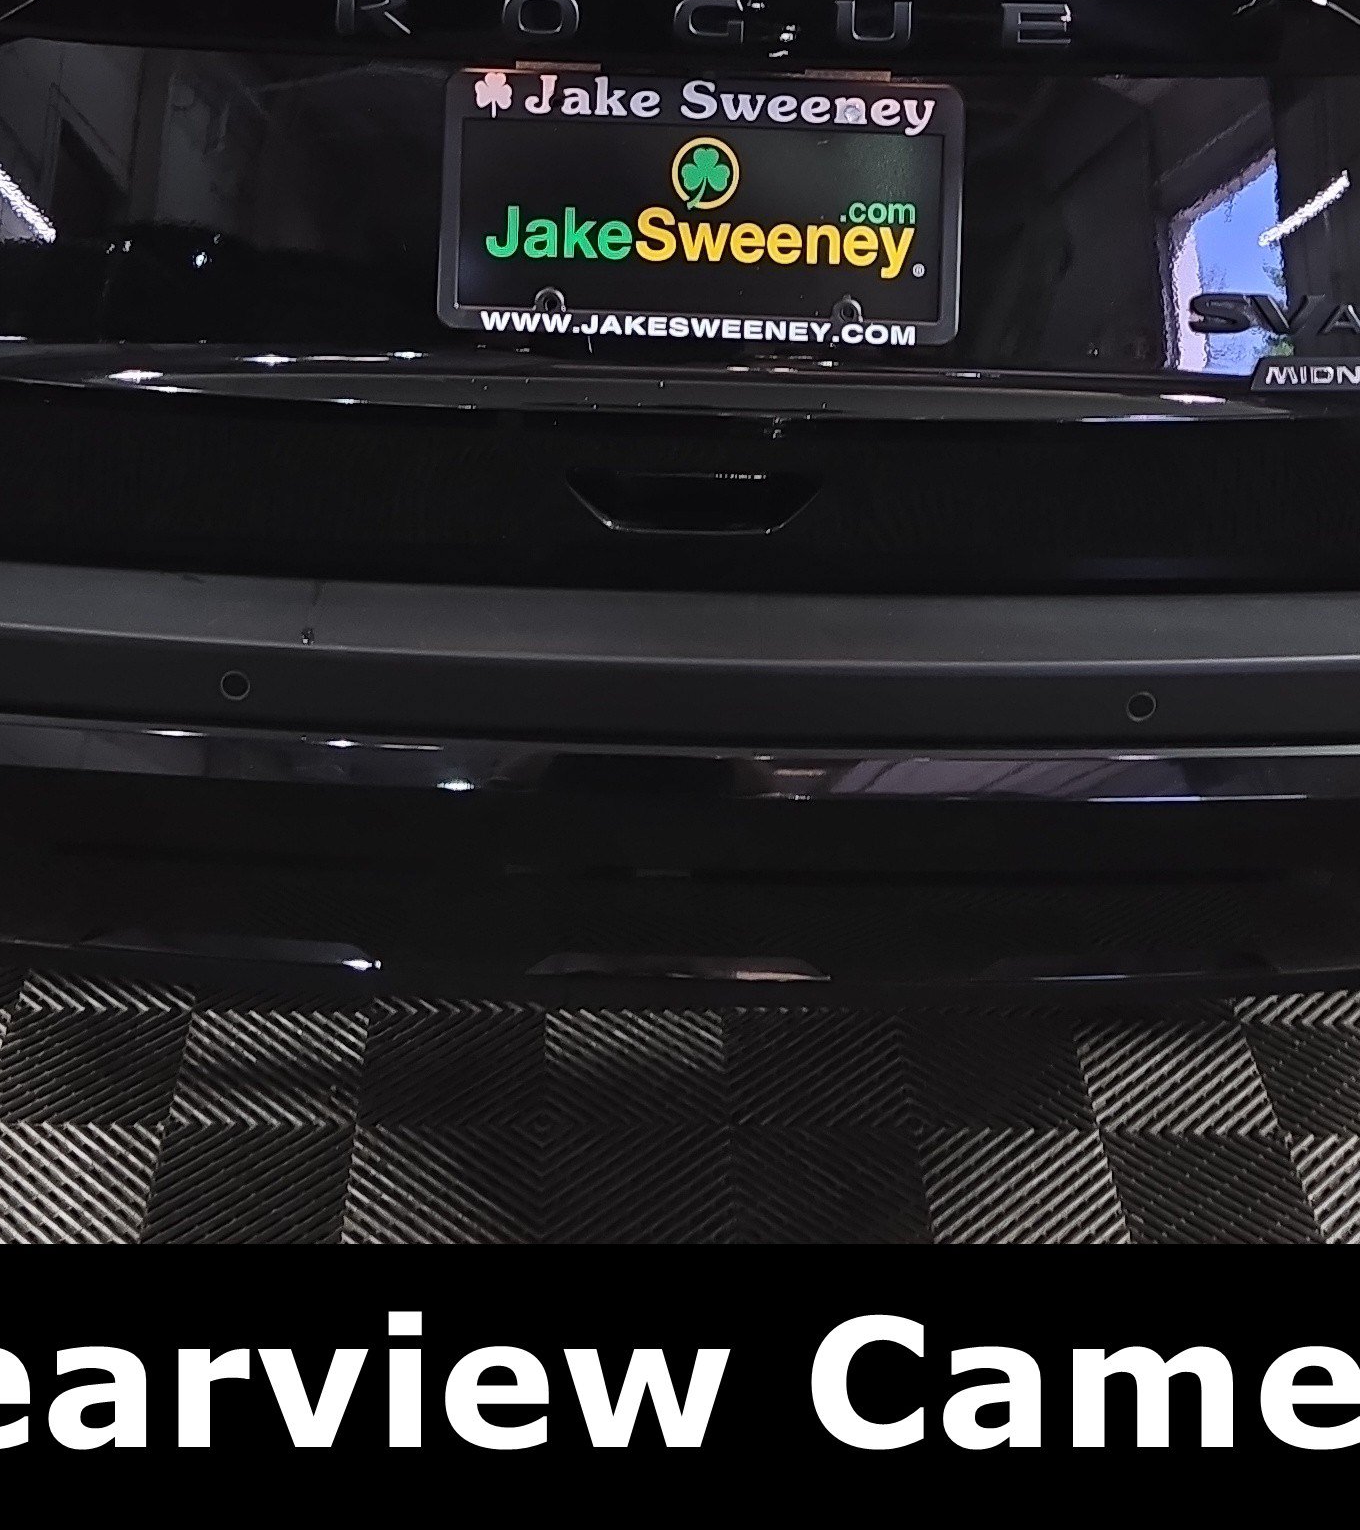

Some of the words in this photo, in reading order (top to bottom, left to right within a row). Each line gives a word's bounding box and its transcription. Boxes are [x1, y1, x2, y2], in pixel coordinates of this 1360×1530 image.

[524, 73, 661, 119] Jake
[680, 79, 936, 137] Sweeney
[479, 310, 917, 347] WWW.JAKESWEENEY.COM
[1189, 293, 1326, 335] SV
